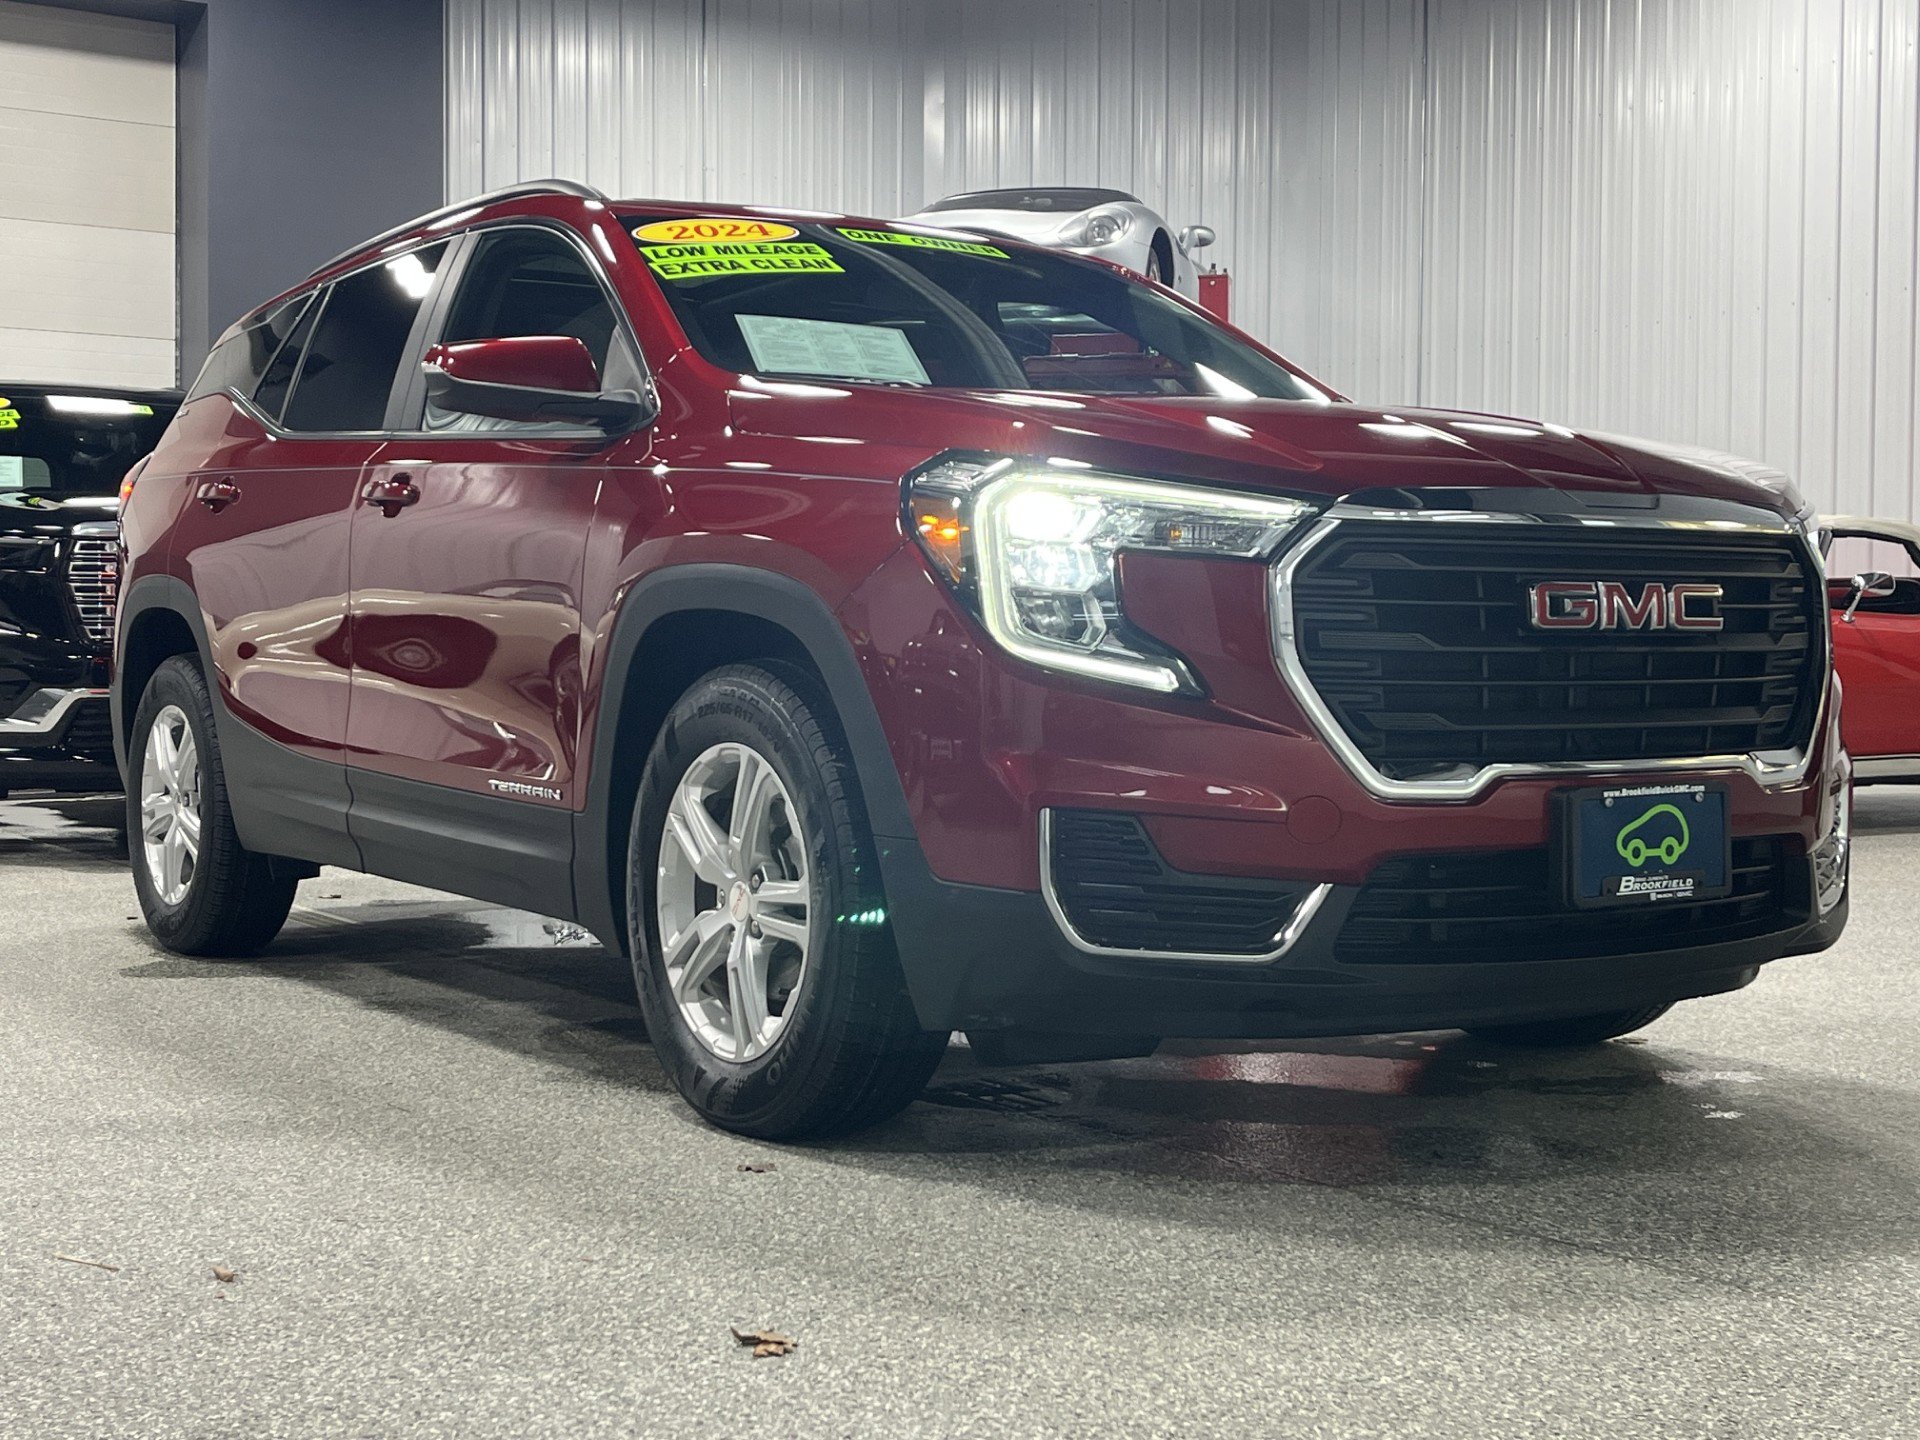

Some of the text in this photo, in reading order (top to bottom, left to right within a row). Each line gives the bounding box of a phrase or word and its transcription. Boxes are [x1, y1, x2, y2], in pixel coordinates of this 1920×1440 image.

[667, 224, 773, 240] 2024
[846, 230, 995, 254] ONE OWNER
[651, 244, 821, 259] LOW MILEAGE
[661, 258, 834, 275] EXTRA CLEAN
[1529, 581, 1724, 630] GMC
[488, 779, 562, 801] TERRAIN
[1619, 876, 1694, 892] BROOKFIELD
